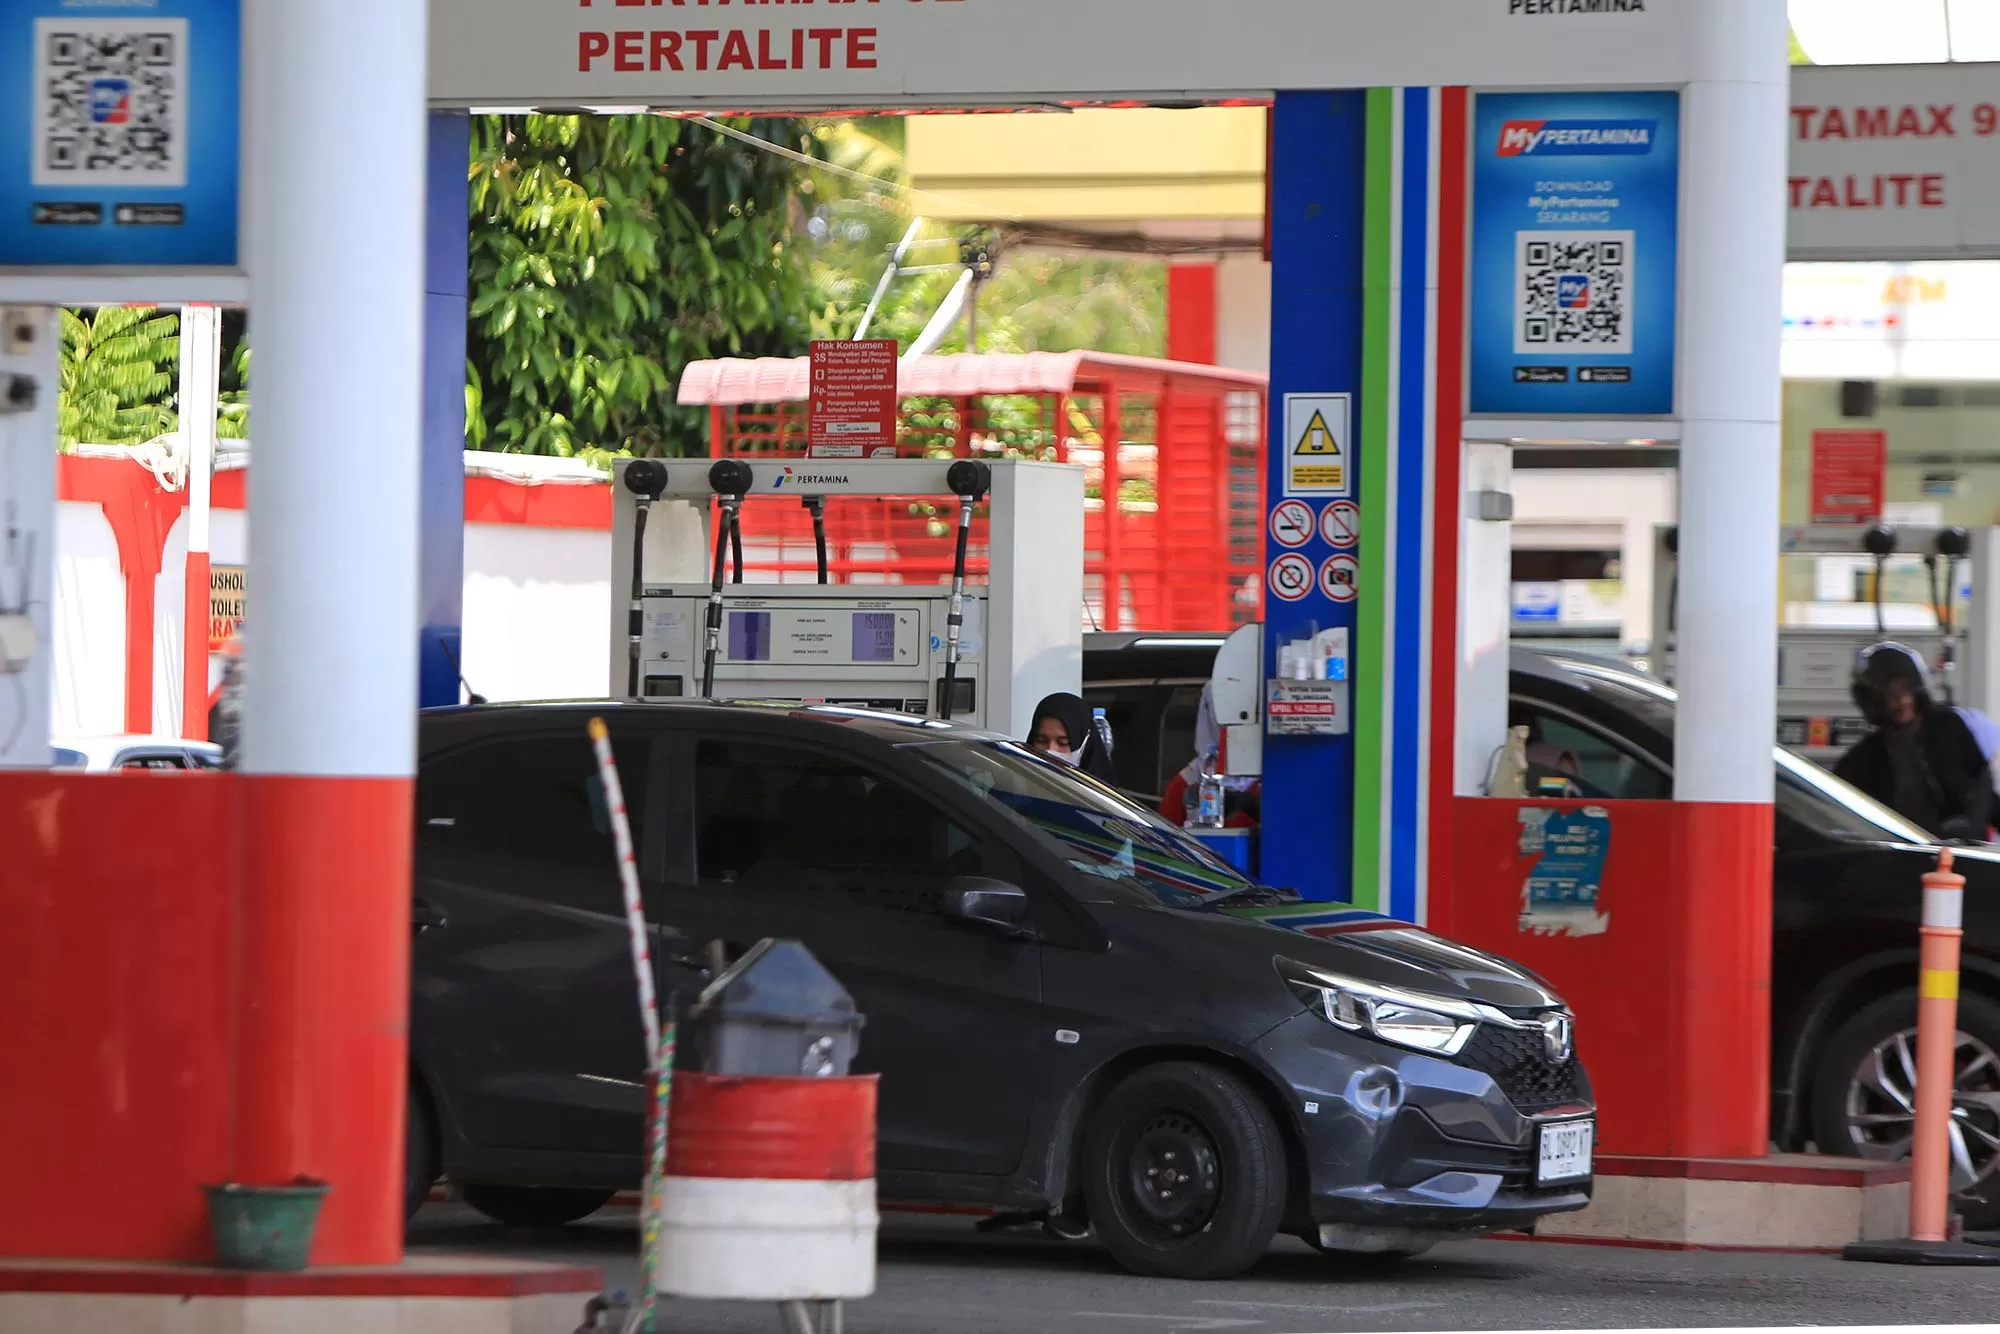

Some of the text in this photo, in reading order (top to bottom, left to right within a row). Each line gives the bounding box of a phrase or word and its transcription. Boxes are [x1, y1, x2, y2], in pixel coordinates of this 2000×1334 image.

[1508, 0, 1646, 14] PERTAMINA
[578, 28, 878, 72] PERTALITE
[1789, 104, 1955, 140] TAMAX
[1535, 181, 1614, 192] DOWNLOAD
[1787, 173, 1947, 208] TALITE
[1528, 195, 1620, 209] MyPertamina
[1537, 211, 1611, 223] SEKARANG
[817, 342, 835, 350] Hak
[836, 342, 884, 350] Konsumen
[814, 352, 826, 363] 3S
[813, 384, 826, 396] Rp.
[797, 475, 849, 484] PERTAMINA
[210, 599, 247, 617] TOILET
